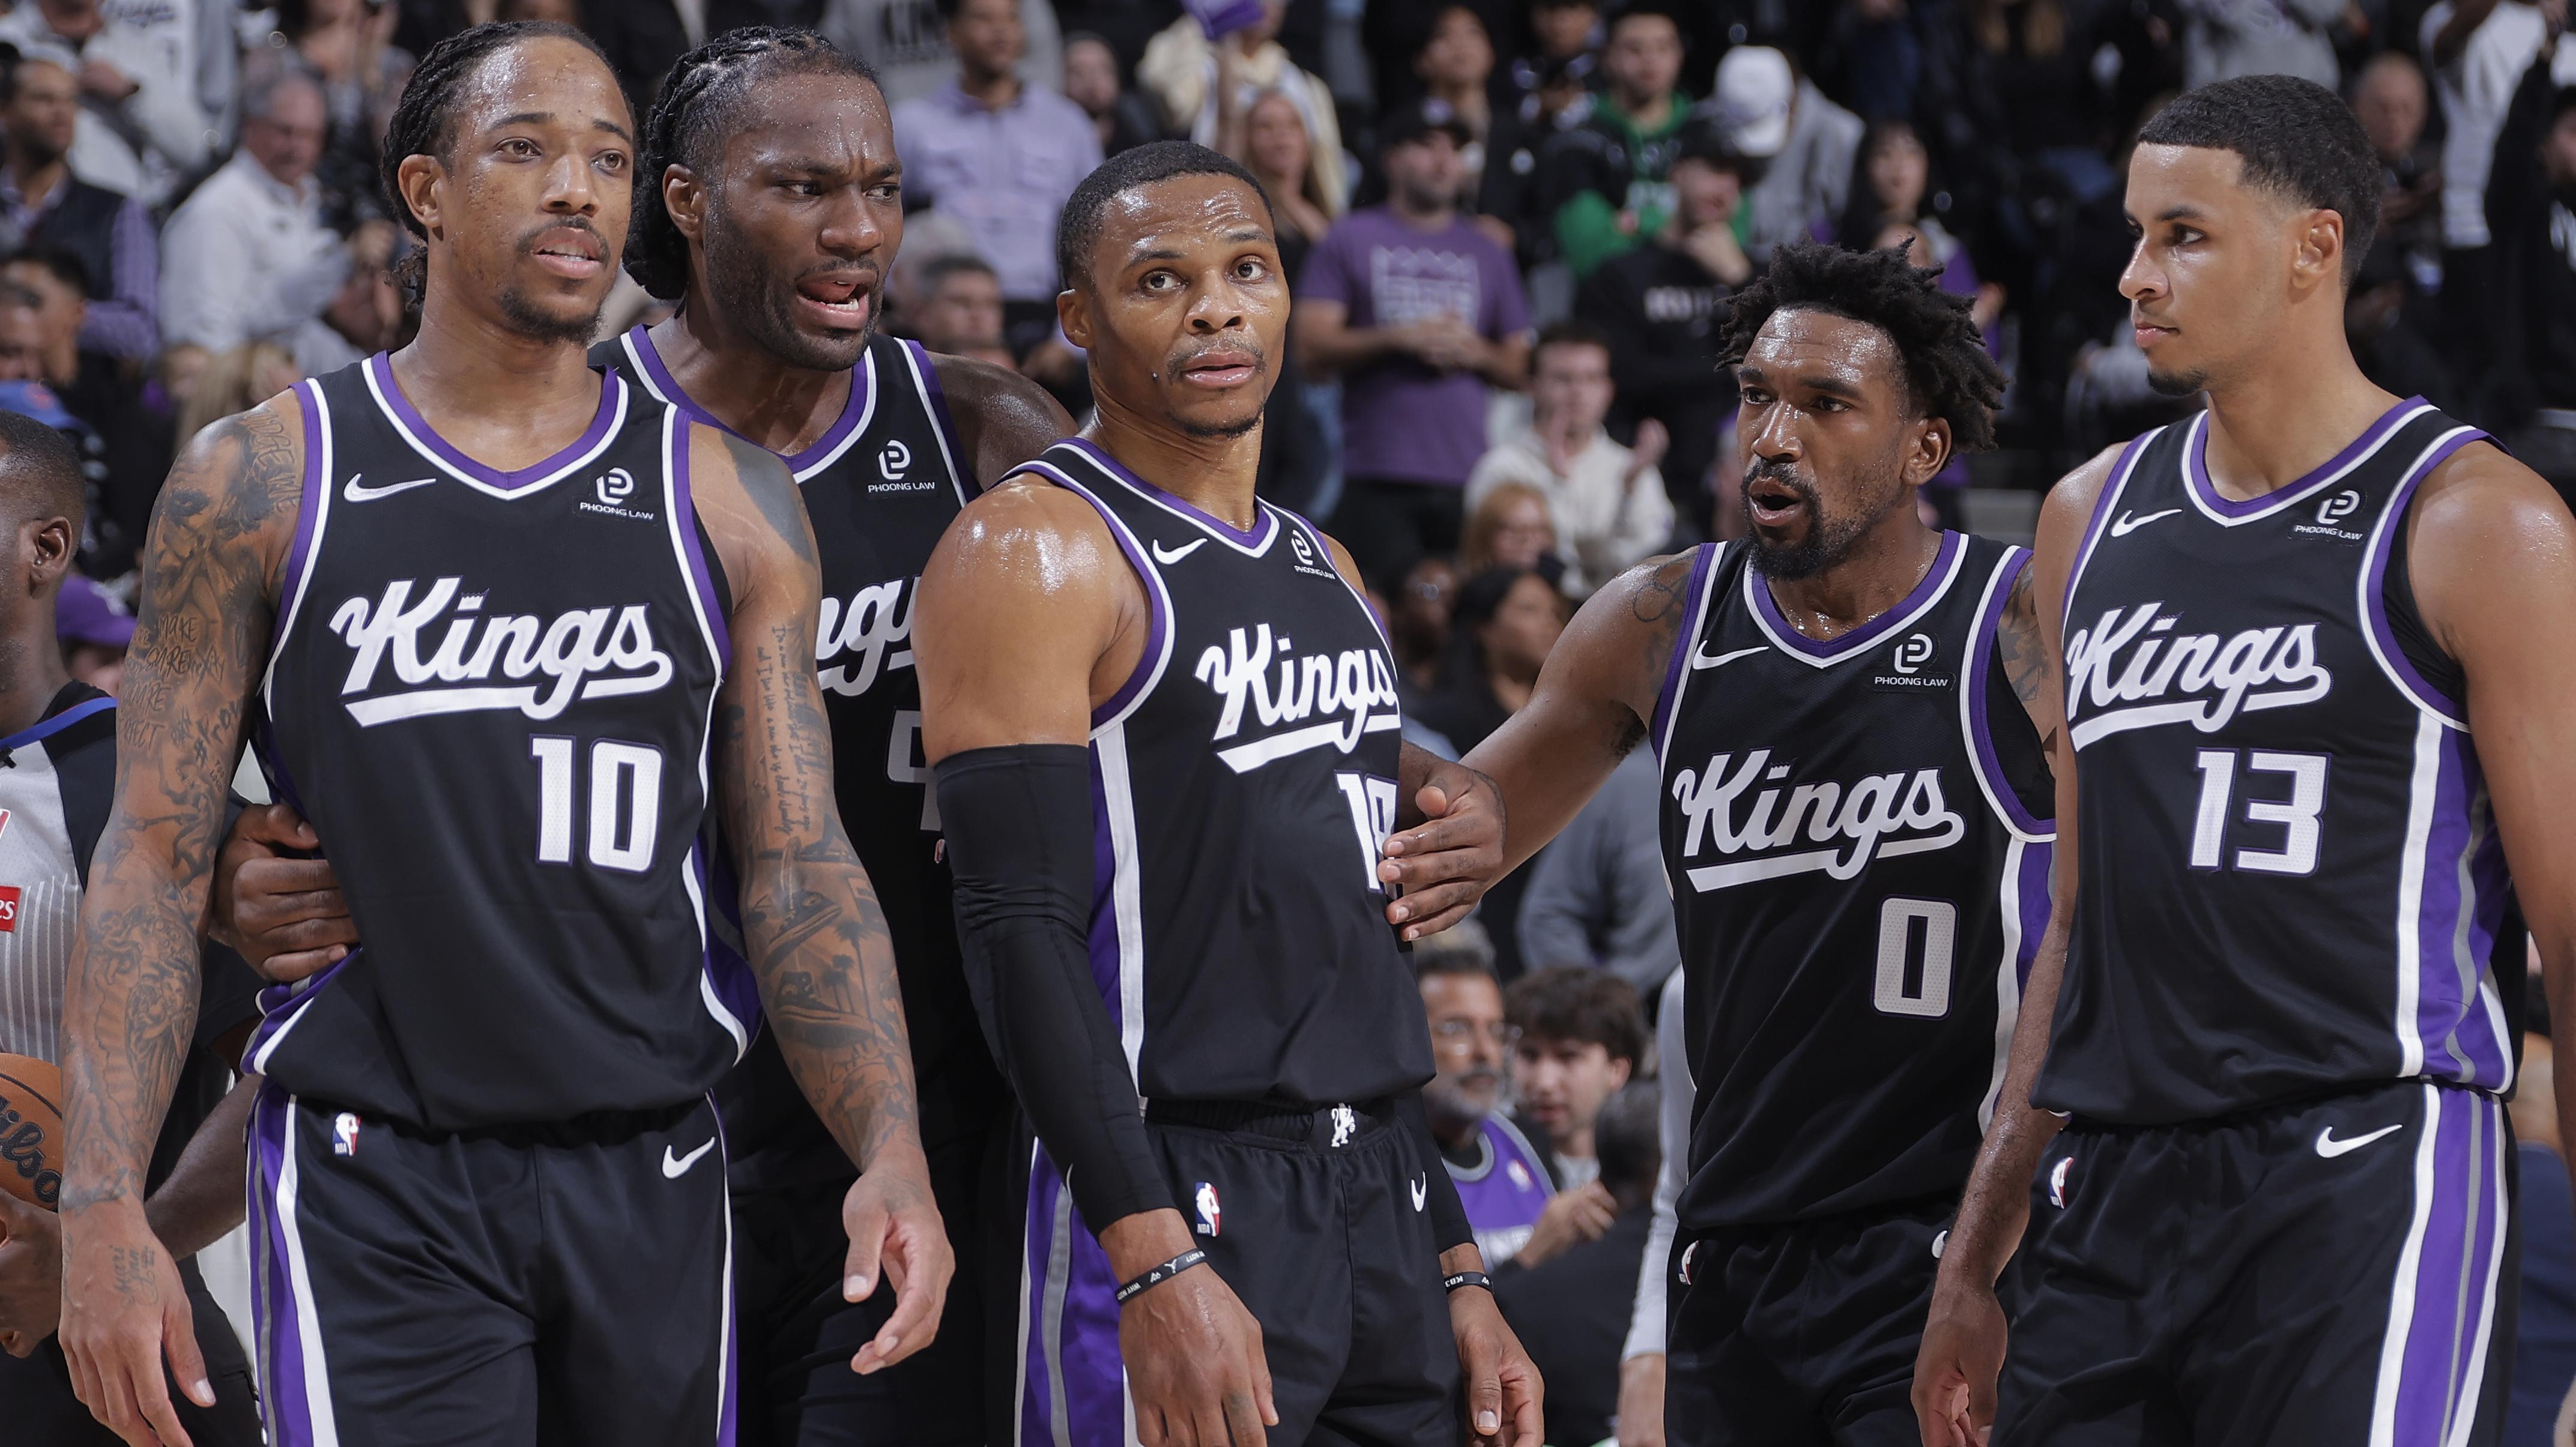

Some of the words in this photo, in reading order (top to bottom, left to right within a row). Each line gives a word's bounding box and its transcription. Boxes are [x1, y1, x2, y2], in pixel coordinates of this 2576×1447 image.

[580, 502, 627, 516] PHOONG
[629, 510, 654, 520] LAW
[868, 483, 912, 492] PHOONG
[2295, 525, 2338, 536] PHOONG
[2339, 530, 2362, 540] LAW
[329, 578, 673, 728] Kings
[1195, 623, 1401, 774] Kings
[1875, 676, 1921, 686] PHOONG
[2067, 603, 2331, 752] Kings
[531, 736, 664, 872] 10
[1672, 749, 1965, 893] Kings
[2189, 751, 2327, 875] 13
[1873, 897, 1956, 1018] 0
[1197, 1224, 1211, 1234] NBA
